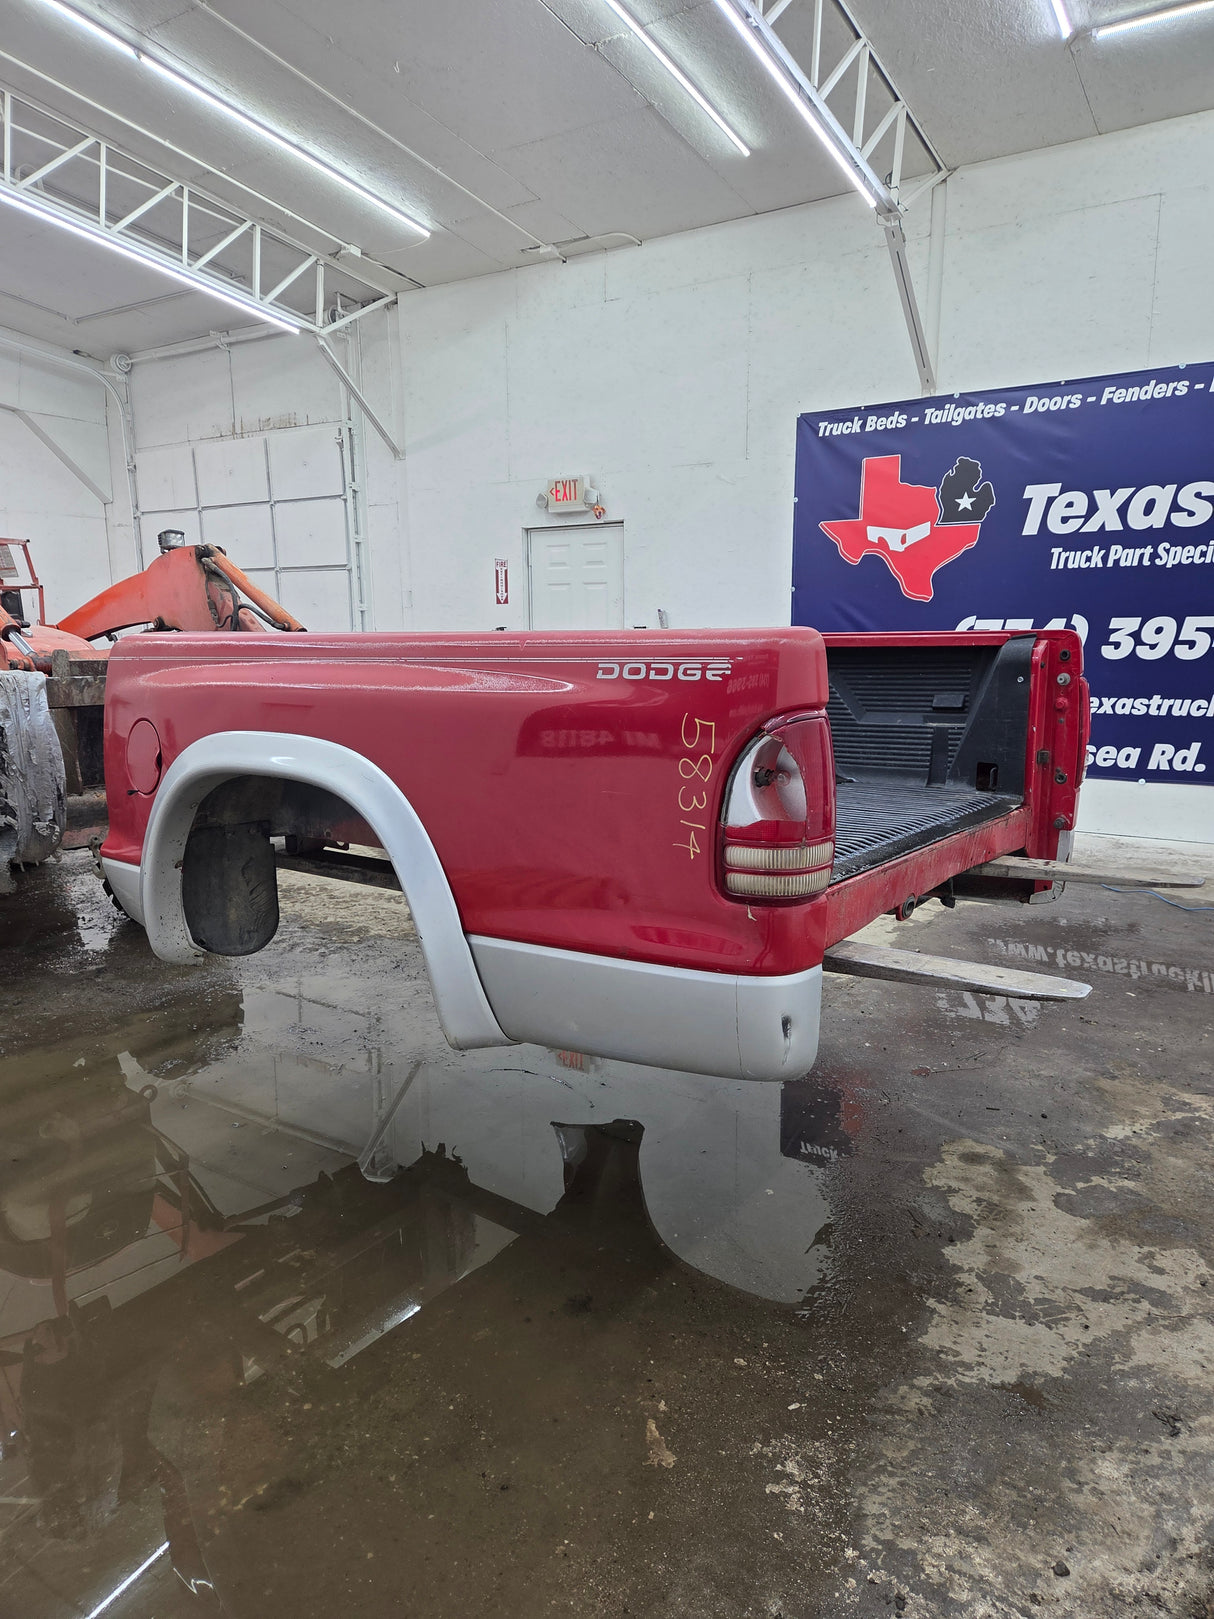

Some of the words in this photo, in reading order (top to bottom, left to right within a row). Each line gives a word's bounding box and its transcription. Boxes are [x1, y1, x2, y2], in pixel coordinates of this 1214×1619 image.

[817, 417, 863, 437] Truck
[865, 411, 908, 432] Beds
[924, 401, 1006, 425] Tailgates
[1023, 393, 1083, 415] Doors
[1100, 377, 1190, 406] Fenders
[554, 479, 578, 502] EXIT
[1021, 481, 1214, 536] Texas
[1050, 545, 1106, 570] Truck
[1106, 544, 1154, 568] Part
[596, 663, 732, 681] DODGE
[1146, 741, 1206, 773] Rd.
[672, 712, 715, 860] 58314
